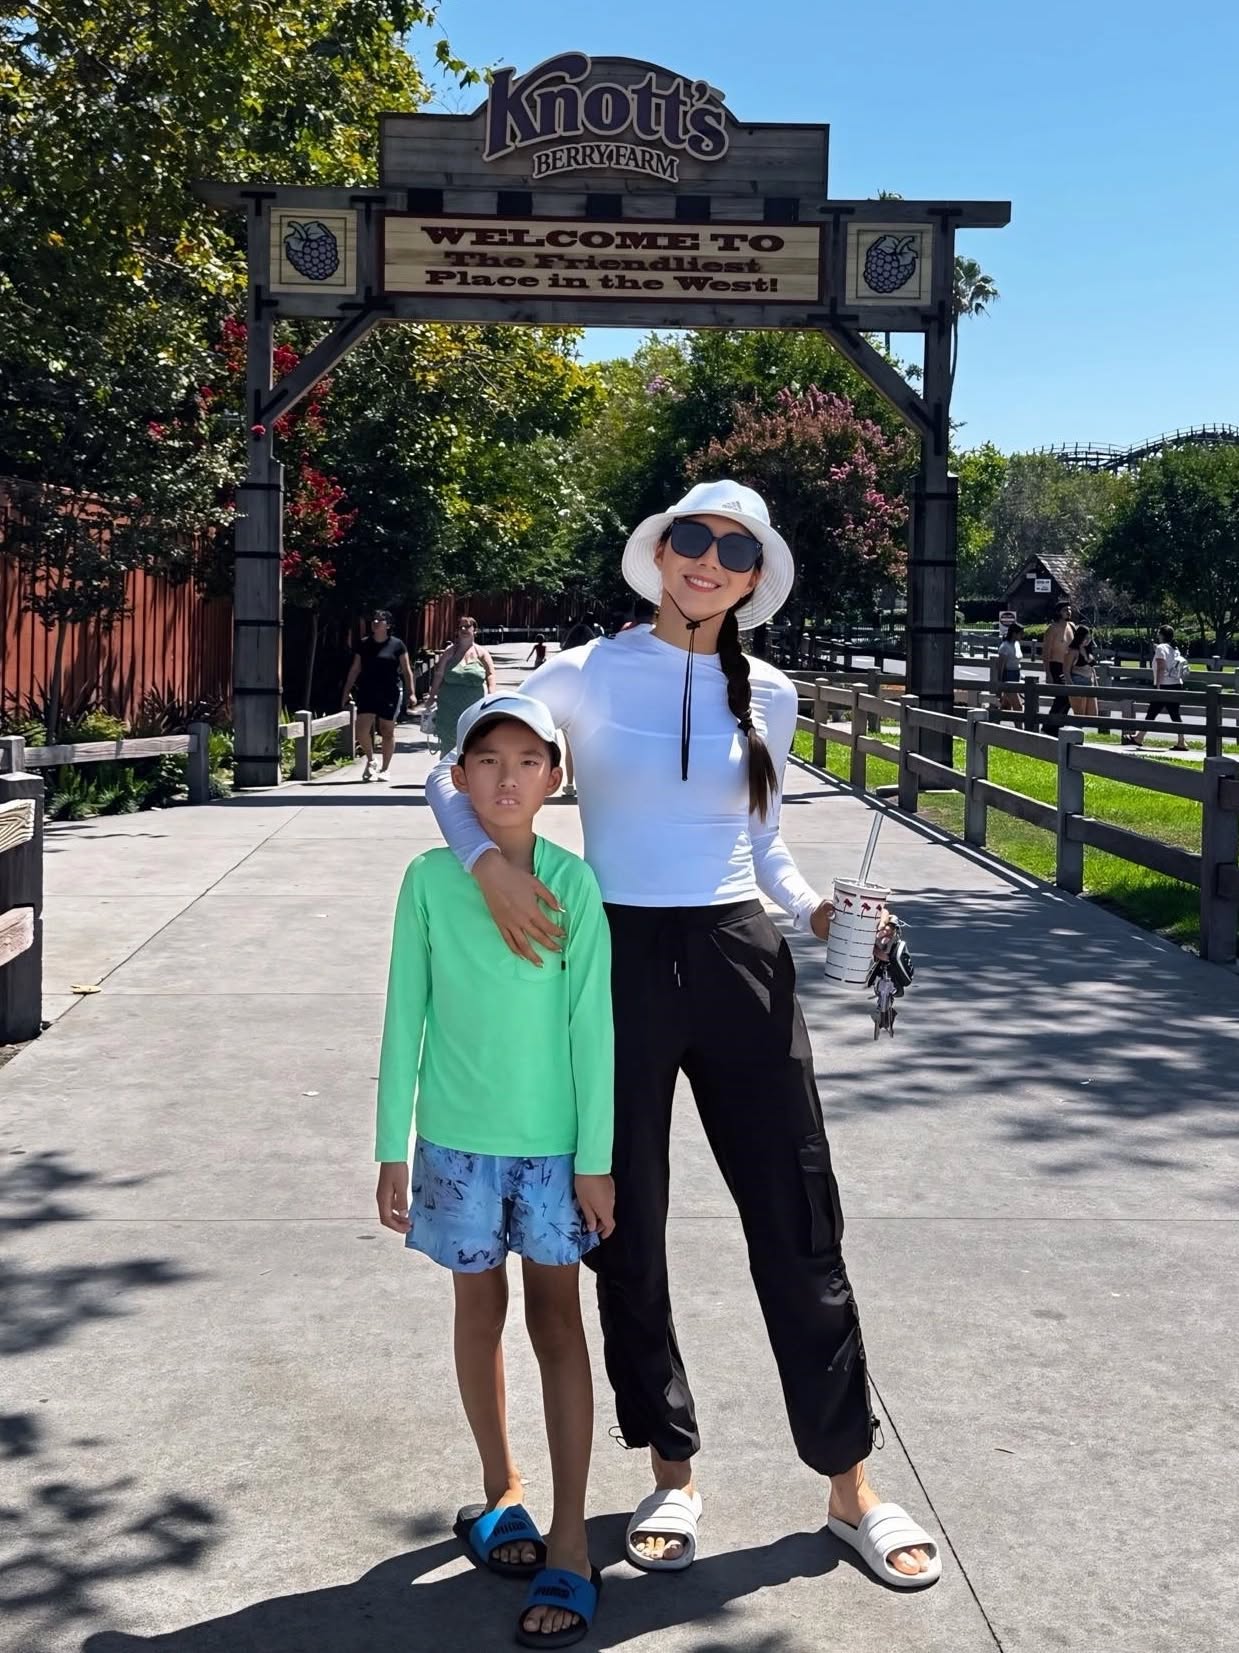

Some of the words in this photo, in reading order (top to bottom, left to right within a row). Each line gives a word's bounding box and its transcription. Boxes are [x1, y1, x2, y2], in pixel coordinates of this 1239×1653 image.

[482, 51, 729, 162] Knott's
[533, 142, 608, 179] BERRY
[613, 142, 679, 182] FARM
[421, 226, 700, 250] WELCOME
[710, 234, 785, 253] TO
[444, 251, 526, 268] The
[534, 254, 761, 273] Friendliest
[425, 270, 540, 287] Place
[548, 273, 590, 289] in
[598, 274, 664, 290] the
[673, 276, 778, 292] West!
